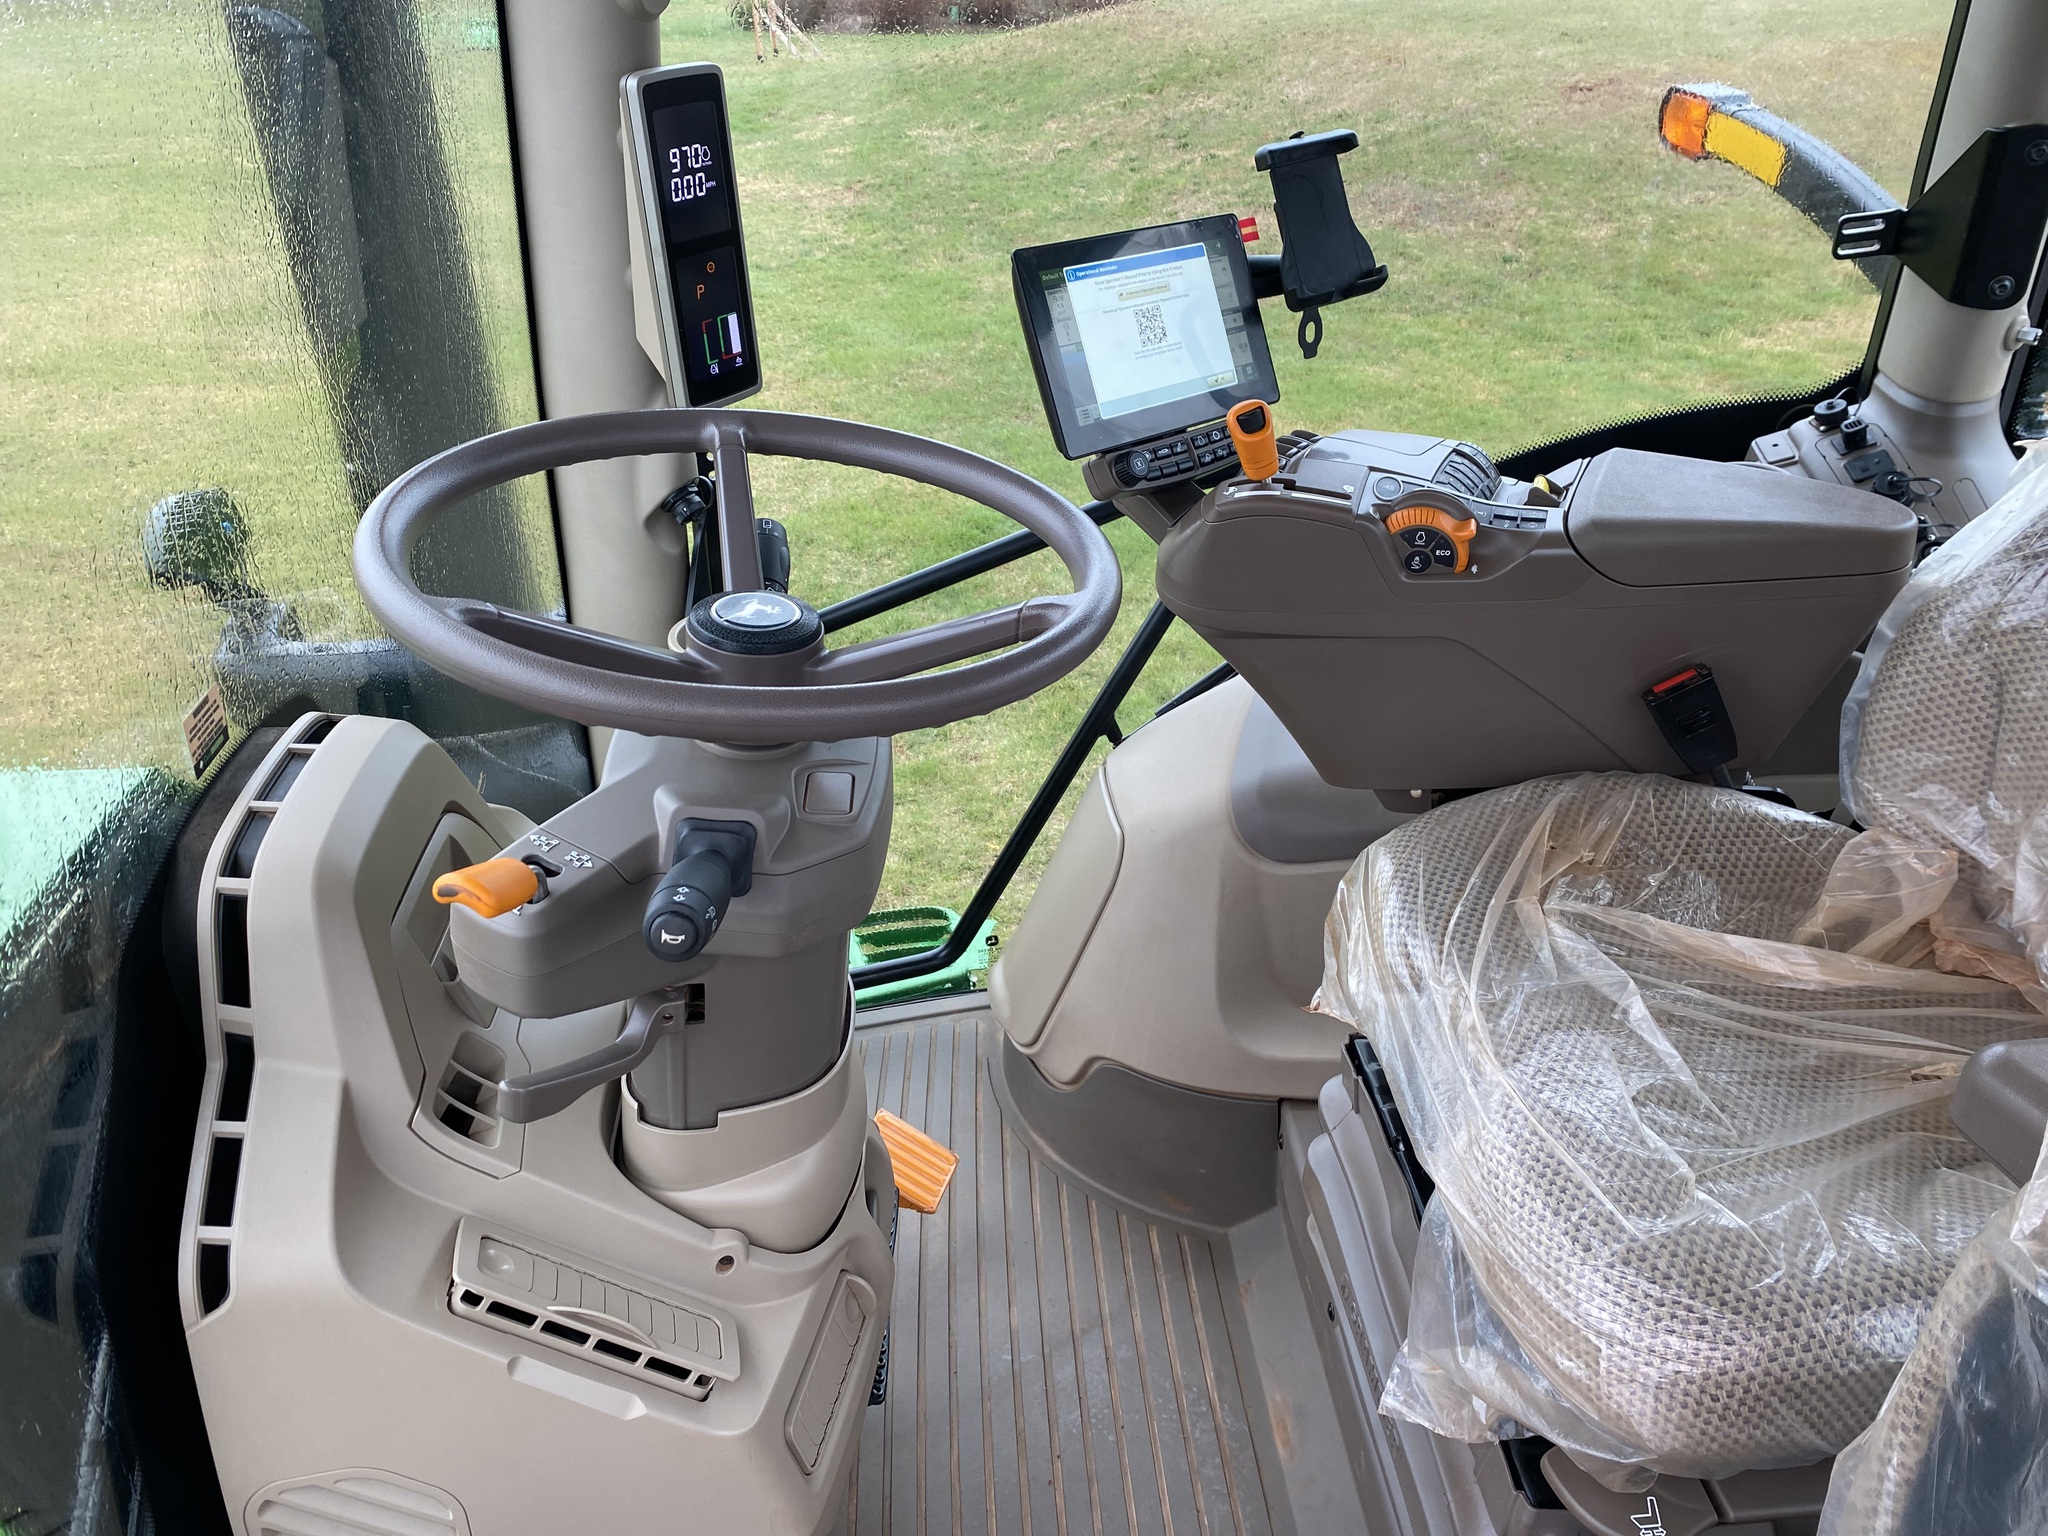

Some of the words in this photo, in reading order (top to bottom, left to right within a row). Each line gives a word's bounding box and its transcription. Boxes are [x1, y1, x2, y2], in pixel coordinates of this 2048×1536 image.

[669, 144, 702, 173] 970
[671, 172, 706, 202] 0.00
[705, 180, 717, 188] MPH
[1041, 272, 1058, 281] Default
[1075, 267, 1099, 277] Operational
[1099, 264, 1118, 272] Reminder
[696, 284, 705, 300] P
